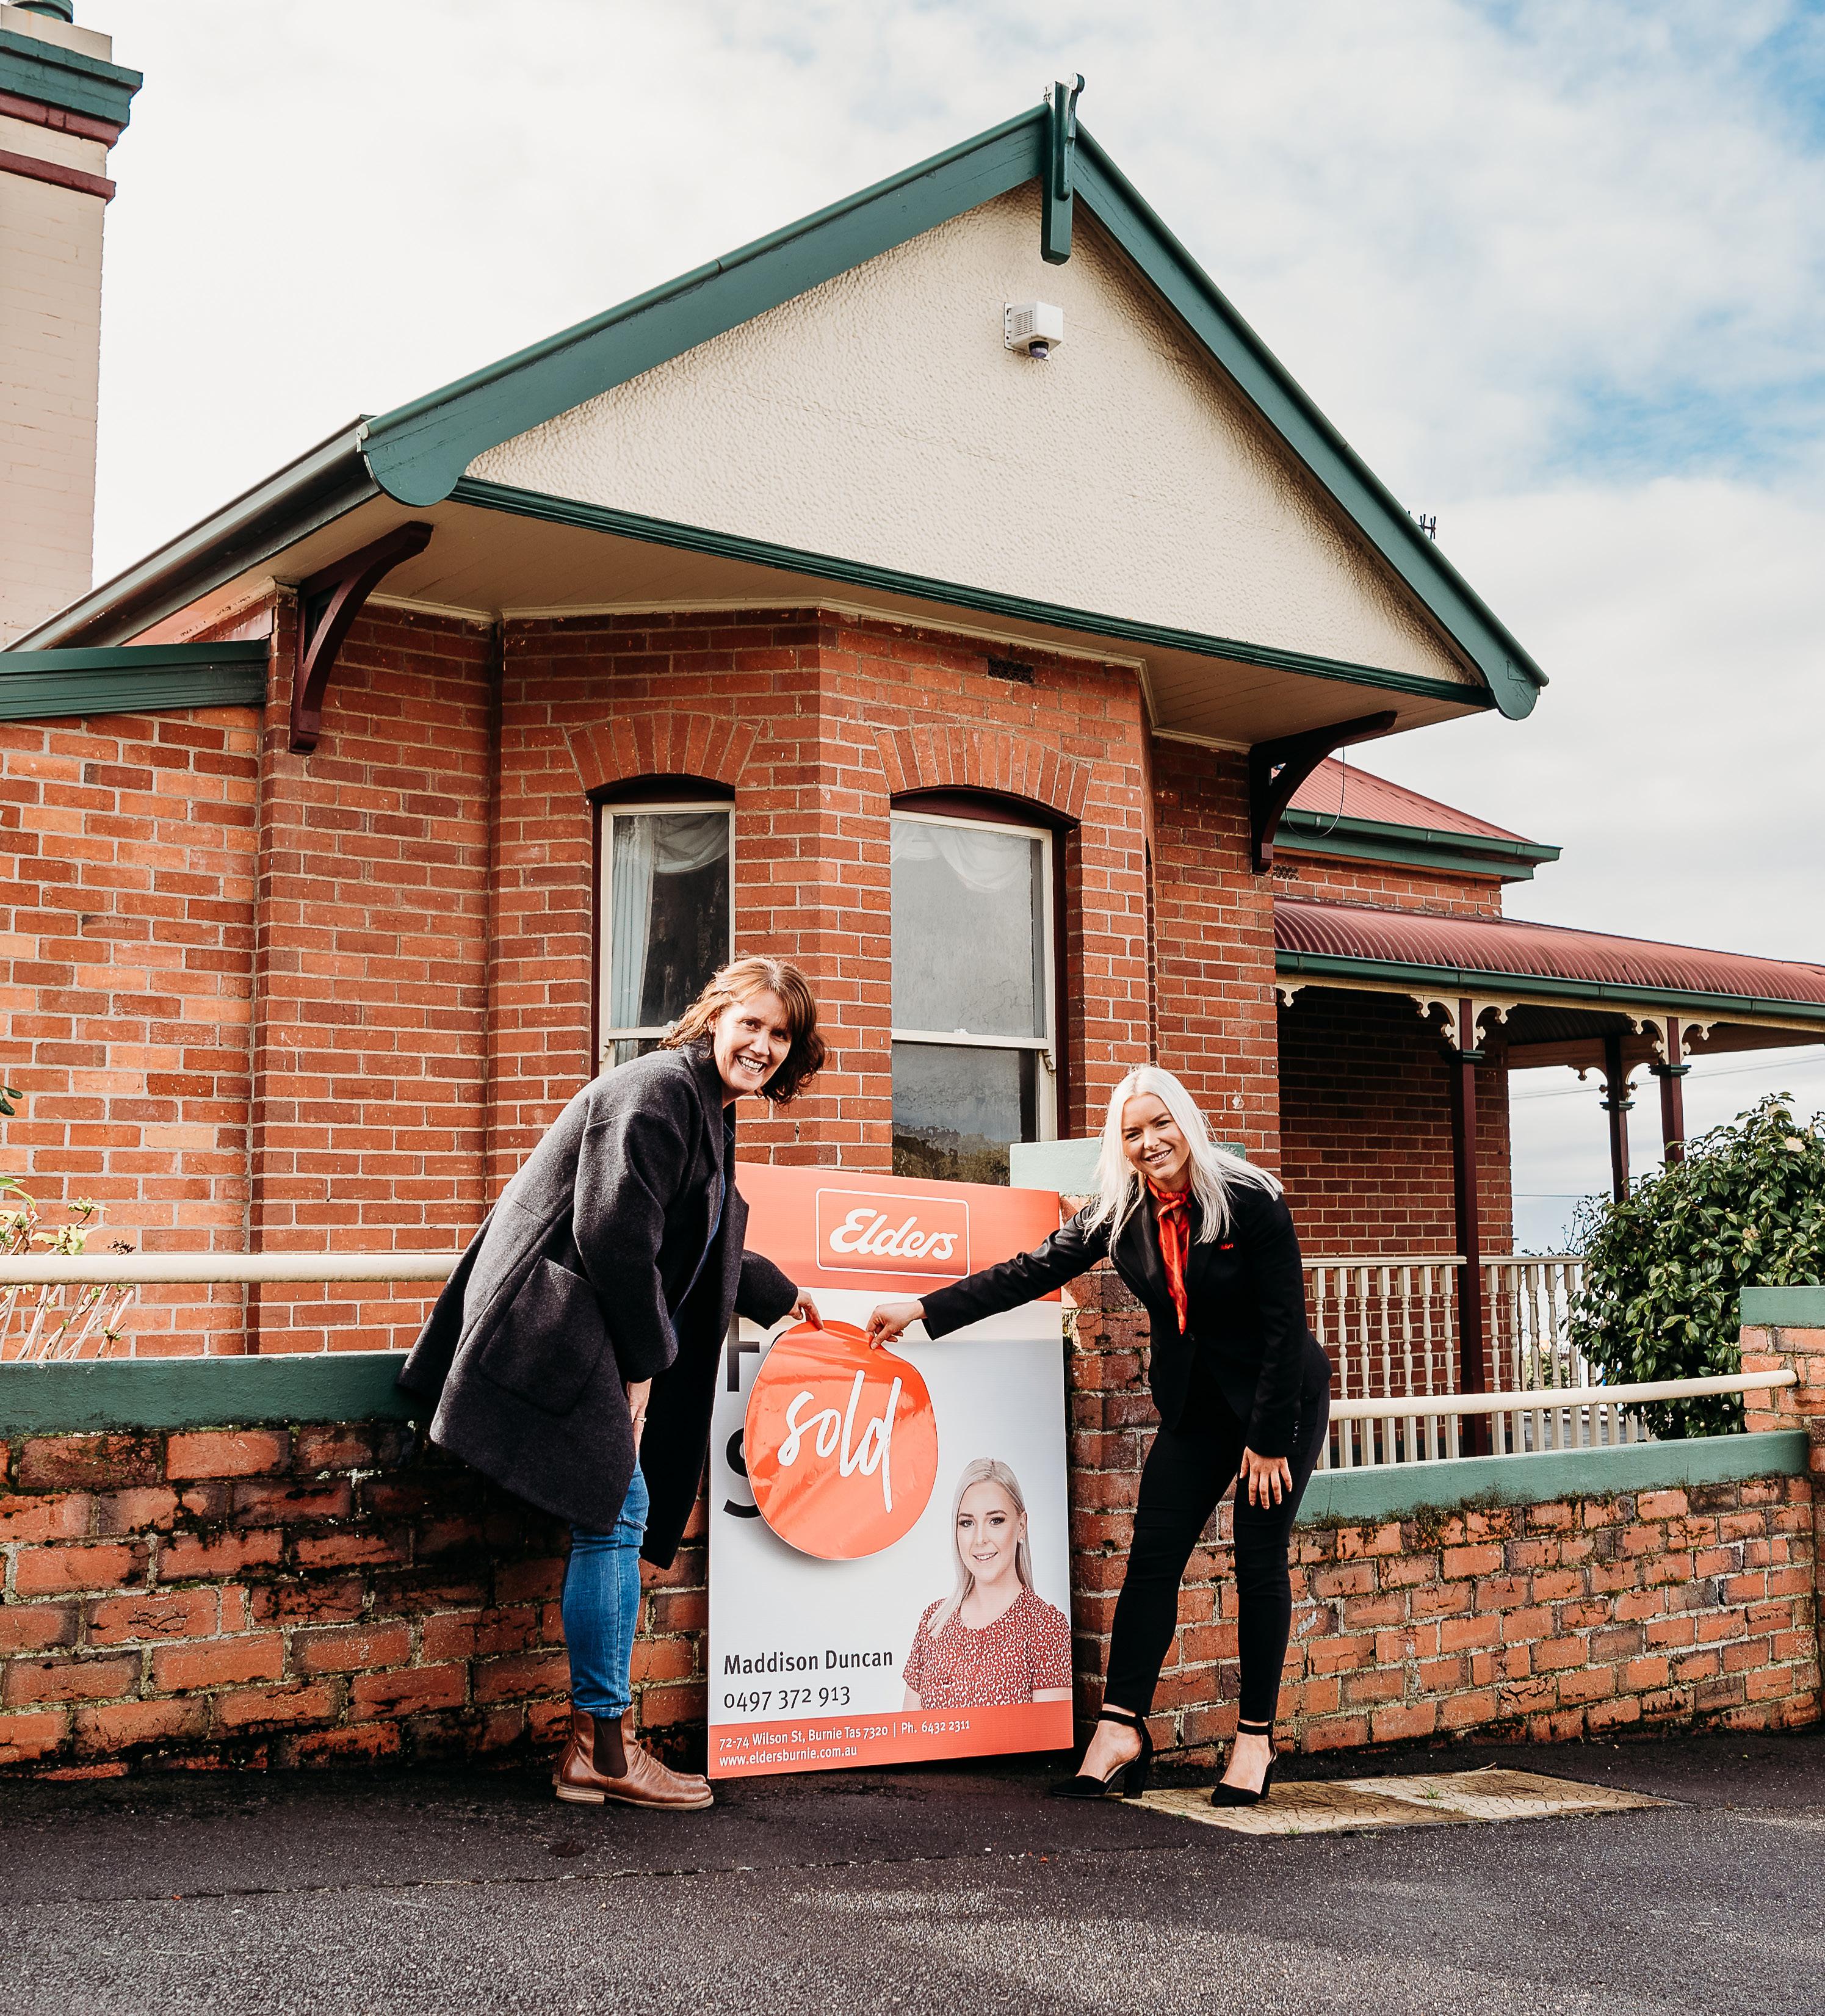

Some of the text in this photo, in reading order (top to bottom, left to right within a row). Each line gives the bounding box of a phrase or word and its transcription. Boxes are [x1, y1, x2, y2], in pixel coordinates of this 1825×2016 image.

[829, 1208, 959, 1260] Elders
[777, 1369, 903, 1514] sold
[724, 1650, 893, 1675] Maddison Duncan
[724, 1686, 850, 1712] 0497 372 913
[719, 1719, 970, 1751] 72-74 Wilson St, Burnie Tas 7320 Ph. 6432 2311
[719, 1746, 857, 1767] www.eldersburnie.com.au
